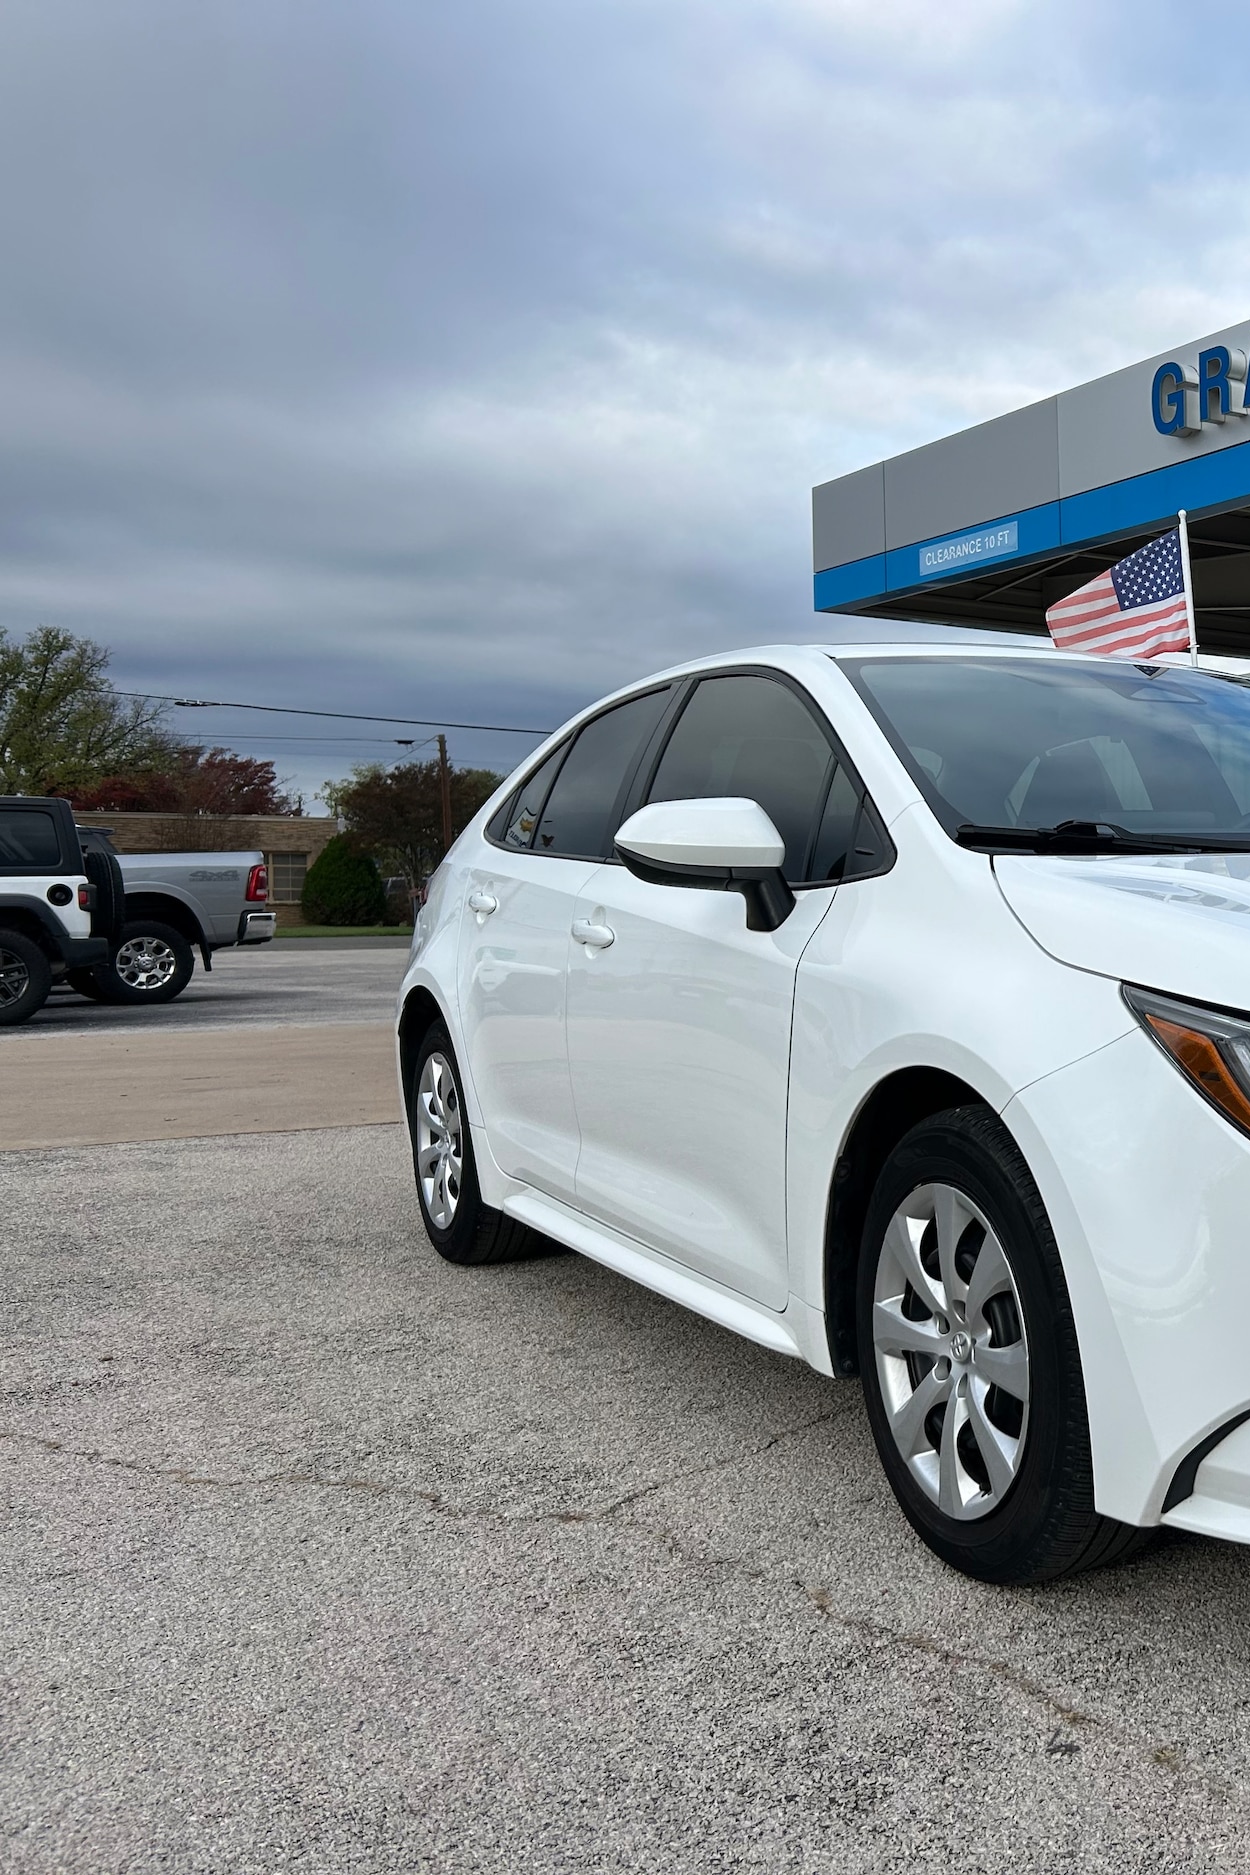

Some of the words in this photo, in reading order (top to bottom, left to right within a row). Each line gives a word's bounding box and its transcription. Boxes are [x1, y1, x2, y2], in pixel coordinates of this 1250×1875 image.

[925, 538, 982, 566] CLEARANCE
[984, 535, 995, 549] 10
[997, 530, 1010, 547] FT
